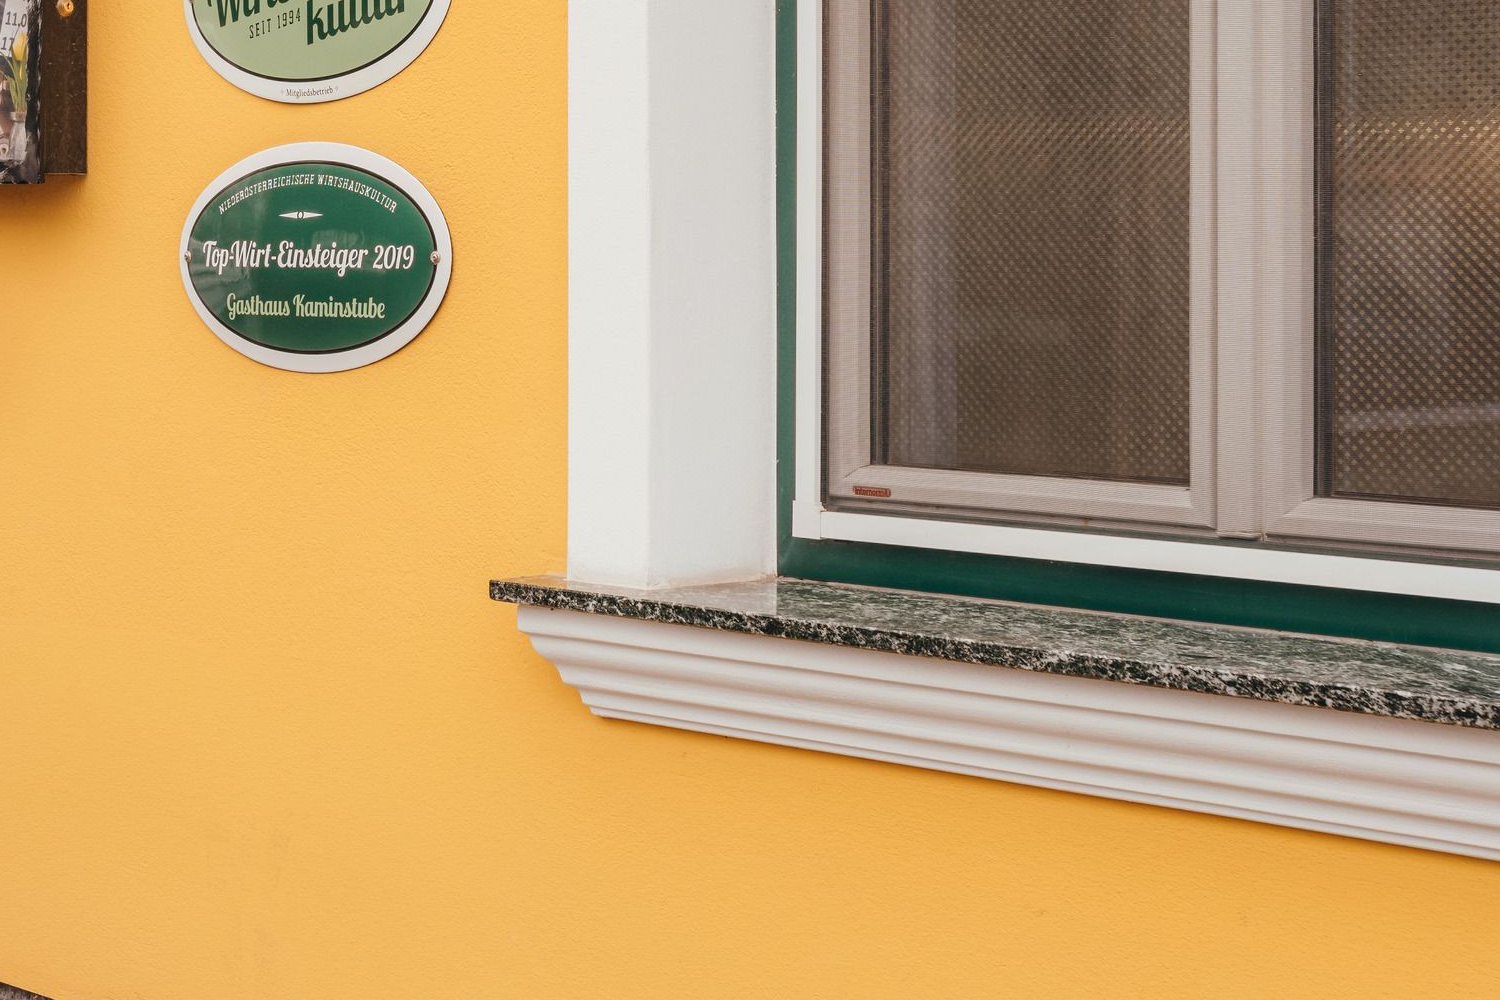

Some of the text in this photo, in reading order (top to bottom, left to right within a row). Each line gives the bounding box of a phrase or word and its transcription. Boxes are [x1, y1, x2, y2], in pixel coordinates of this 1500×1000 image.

[249, 8, 301, 39] SEIT 1994
[286, 86, 334, 99] Mitgliedsbetrieb
[317, 174, 398, 213] WIRTSHAUSKULTUR
[202, 240, 415, 277] Top-Wirt-Einsteiger 2019
[226, 292, 386, 320] Gasthaus Kaminstube
